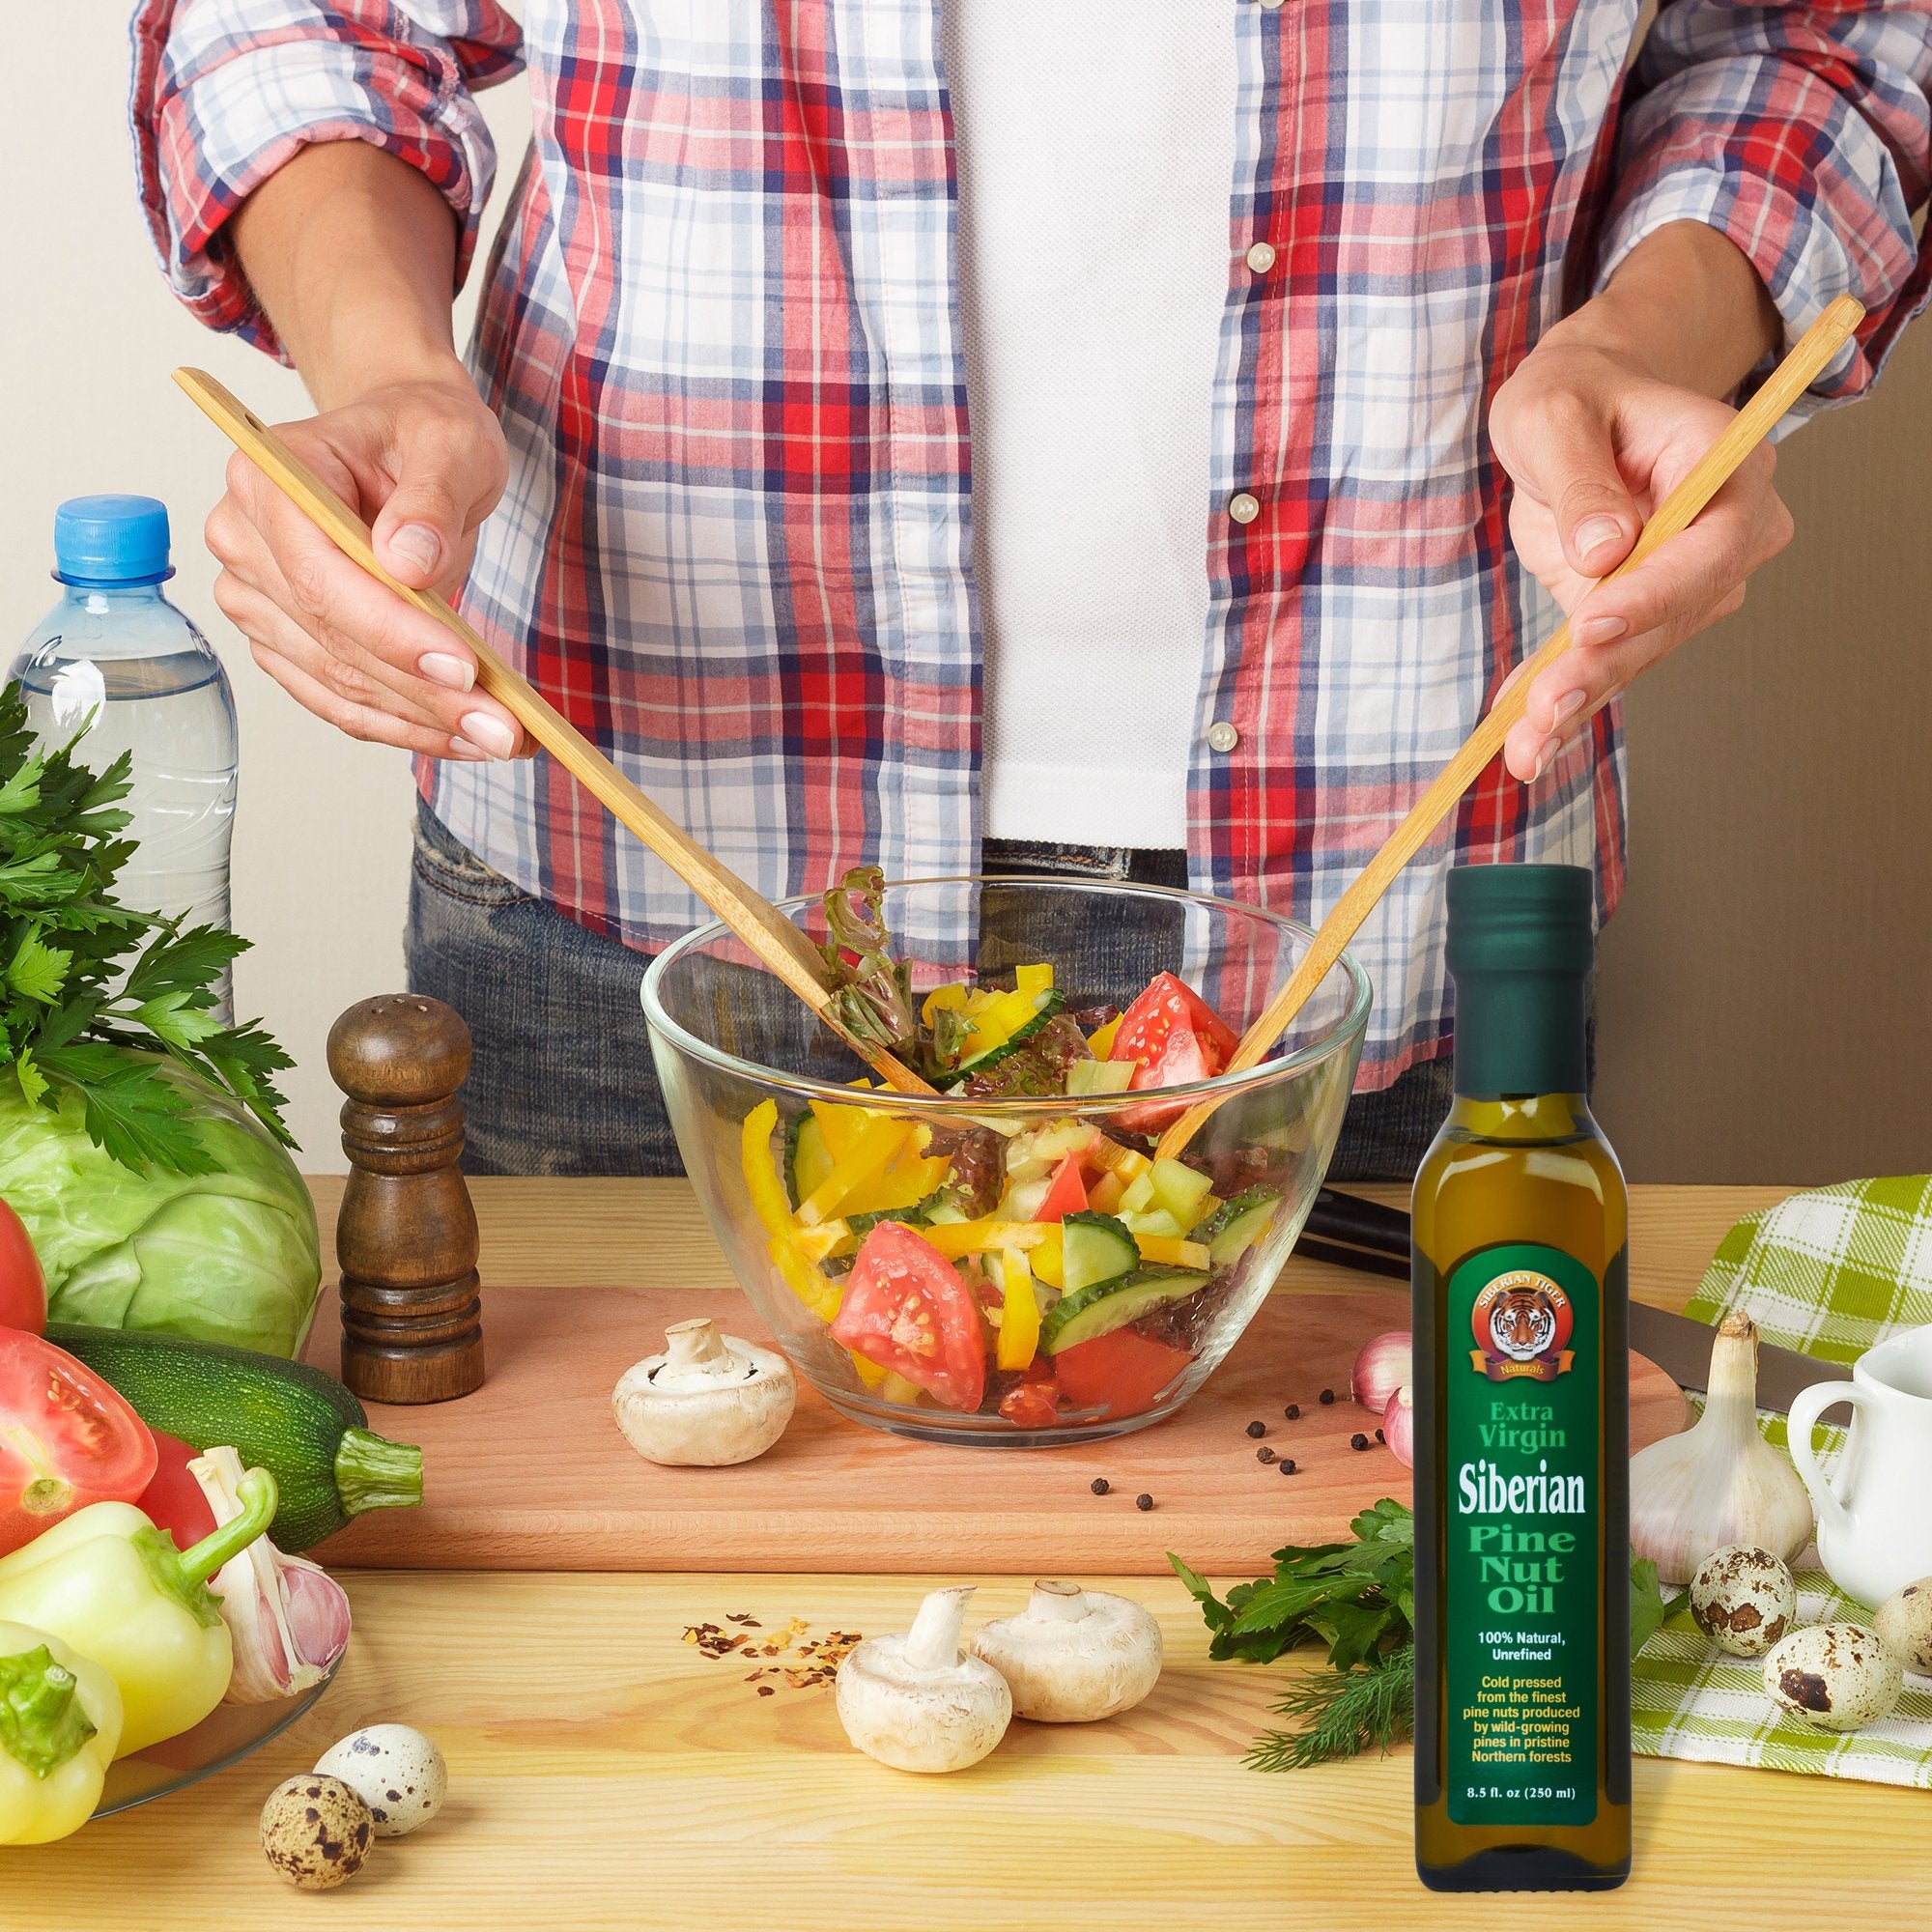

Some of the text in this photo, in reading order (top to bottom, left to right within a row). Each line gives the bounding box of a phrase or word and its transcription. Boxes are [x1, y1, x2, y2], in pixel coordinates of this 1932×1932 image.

[1478, 1274, 1566, 1309] SIBERIAN TIGER
[1500, 1364, 1545, 1375] Naturals
[1491, 1402, 1554, 1421] Extra
[1478, 1422, 1567, 1455] Virgin
[1458, 1459, 1586, 1515] Siberian
[1467, 1523, 1577, 1553] Pine
[1479, 1555, 1565, 1583] Nut
[1488, 1584, 1556, 1613] Oil
[1478, 1631, 1566, 1646] 100% Natural,
[1492, 1648, 1551, 1661] Unrefined
[1481, 1675, 1562, 1690] Cold pressed
[1477, 1690, 1567, 1703] from the finest
[1463, 1706, 1580, 1720] pine nuts produced
[1473, 1720, 1570, 1736] by wild-growing
[1473, 1736, 1570, 1750] pines in pristine
[1471, 1749, 1572, 1763] Northern forests
[1466, 1787, 1576, 1801] 8.5 fl. oz (250 ml)
